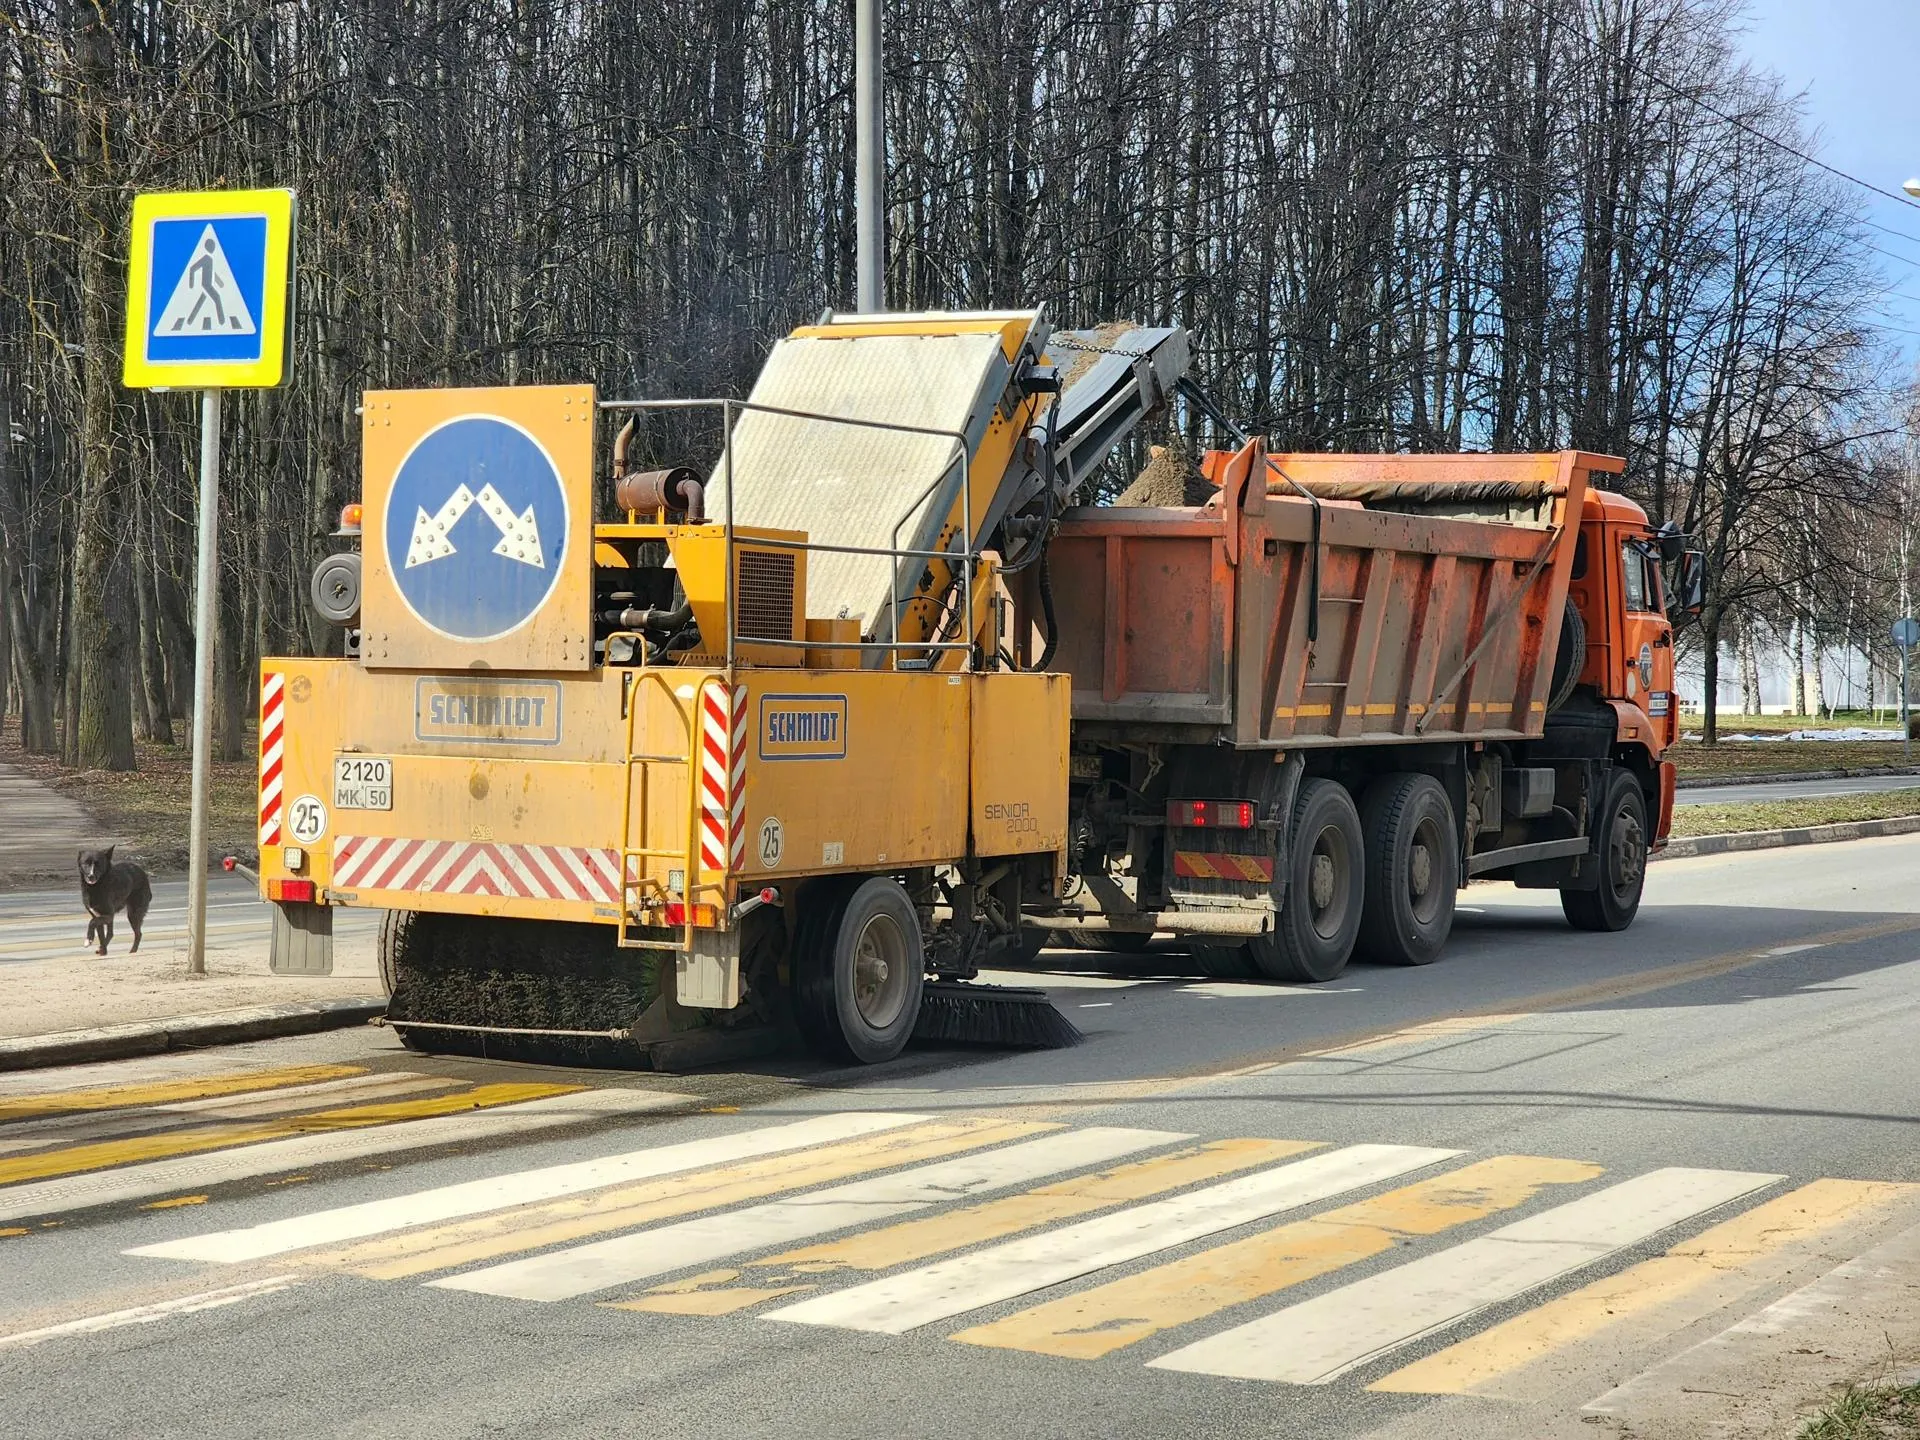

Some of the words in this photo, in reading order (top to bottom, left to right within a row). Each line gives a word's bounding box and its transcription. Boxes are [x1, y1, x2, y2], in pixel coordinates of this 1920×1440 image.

[430, 694, 547, 728] SCHMIDT
[768, 711, 839, 743] SCHMIDT
[341, 761, 385, 782] 2120
[337, 789, 360, 805] MK
[370, 790, 387, 806] 50
[296, 803, 320, 835] 25
[984, 803, 1030, 820] SENIOR
[1006, 817, 1038, 833] 2000
[763, 826, 779, 859] 25
